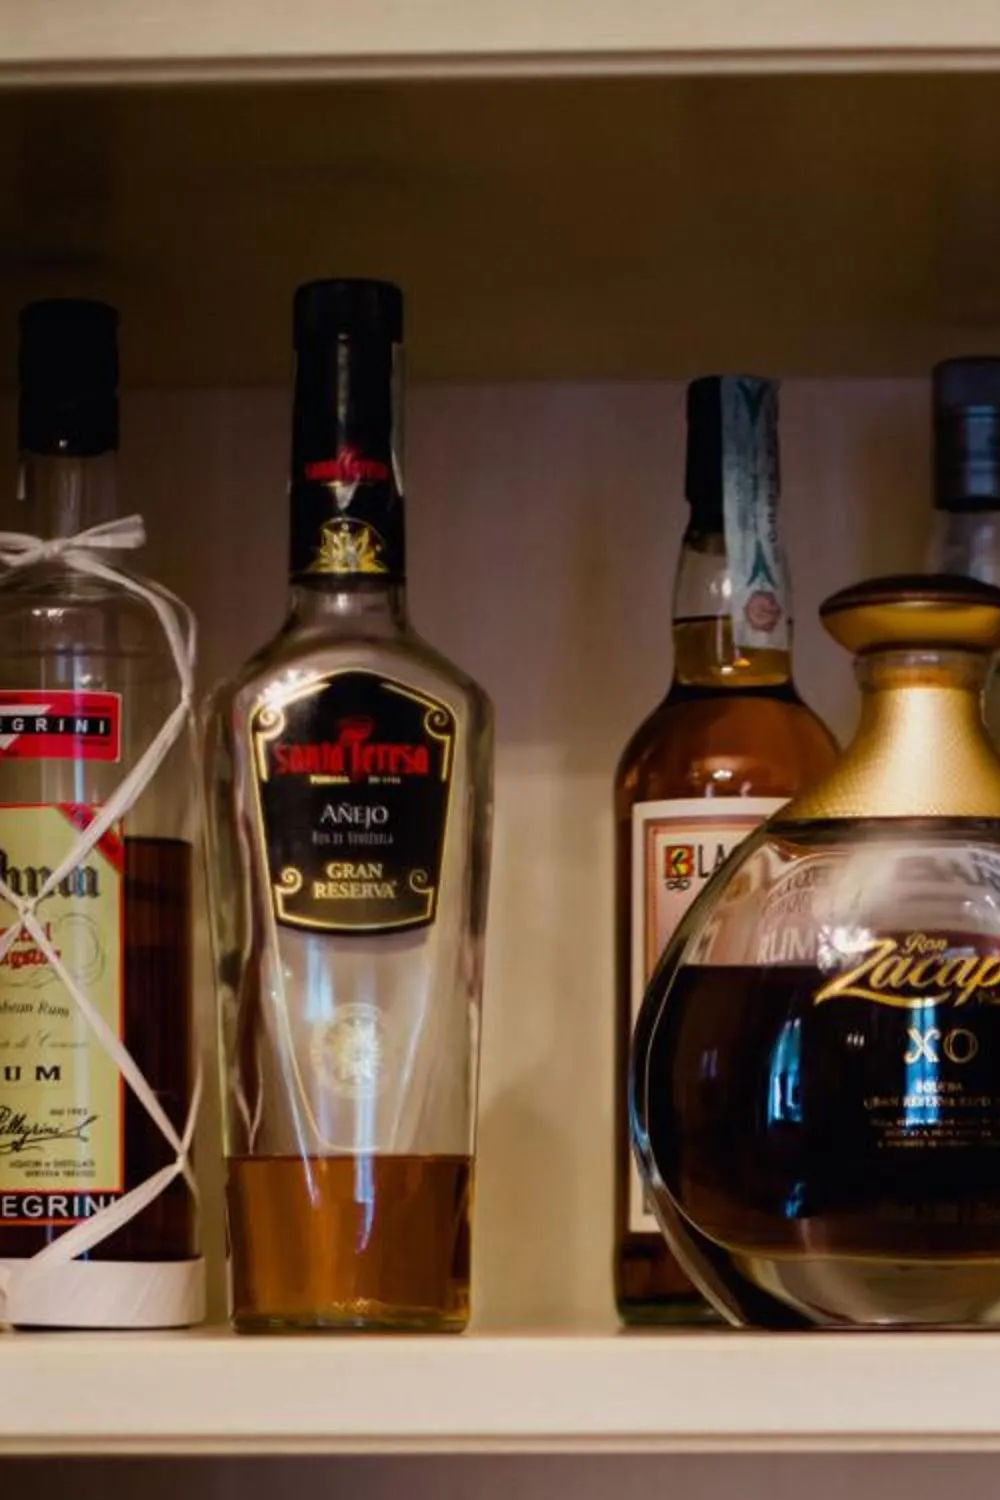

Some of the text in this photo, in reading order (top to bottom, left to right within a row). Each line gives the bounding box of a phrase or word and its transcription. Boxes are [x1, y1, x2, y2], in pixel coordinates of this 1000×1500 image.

[0, 718, 105, 734] GRINI
[320, 802, 389, 829] AÑEJO
[326, 863, 384, 879] GRAN
[312, 881, 396, 900] RESERVA
[904, 1027, 979, 1063] XO
[1, 1195, 117, 1217] EGRIN
